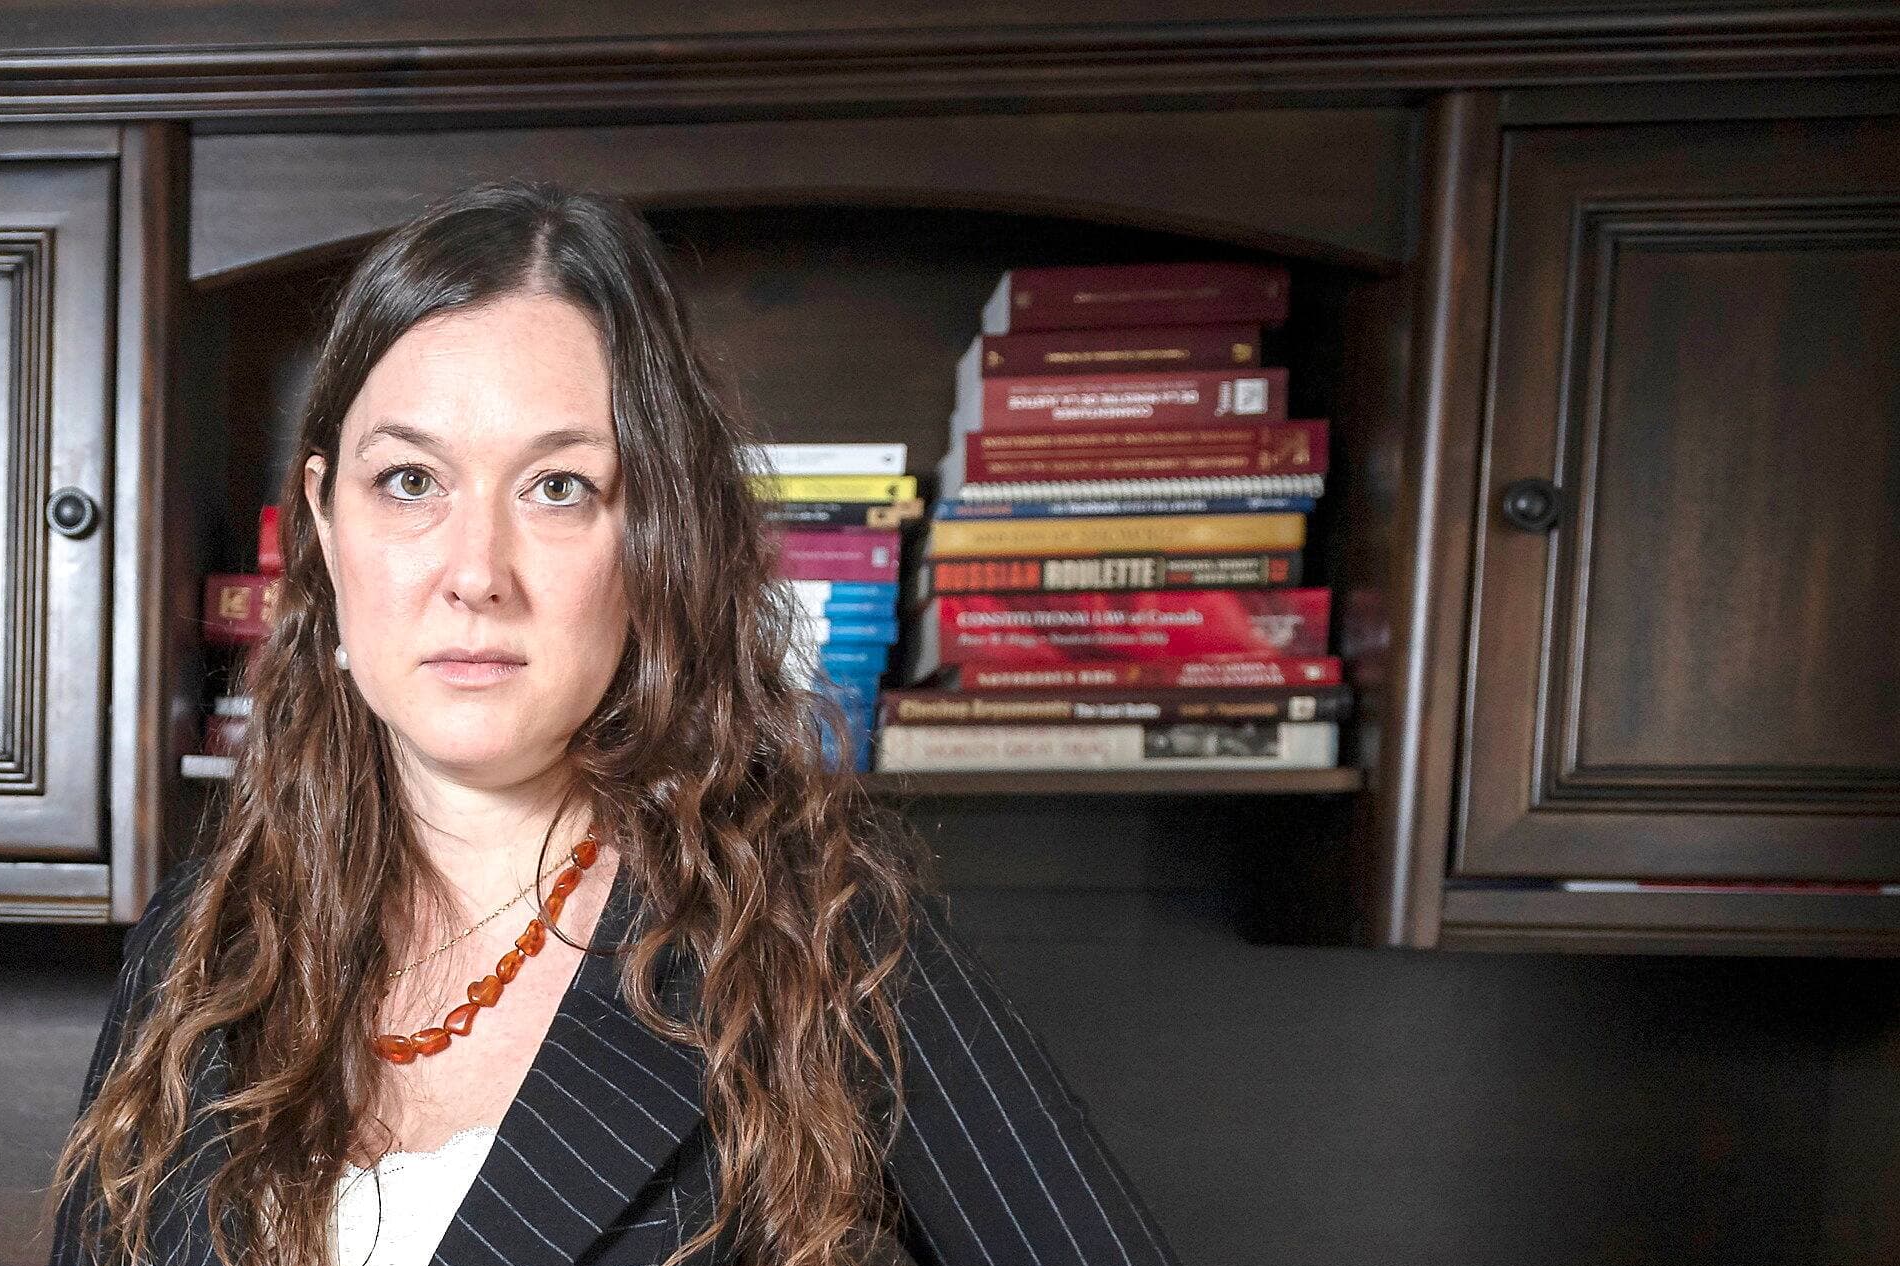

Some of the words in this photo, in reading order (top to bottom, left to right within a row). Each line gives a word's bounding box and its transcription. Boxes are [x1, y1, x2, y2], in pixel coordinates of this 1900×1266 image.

[1043, 558, 1156, 589] ROULETTE
[1093, 610, 1125, 625] LAW
[1142, 609, 1203, 625] Canada
